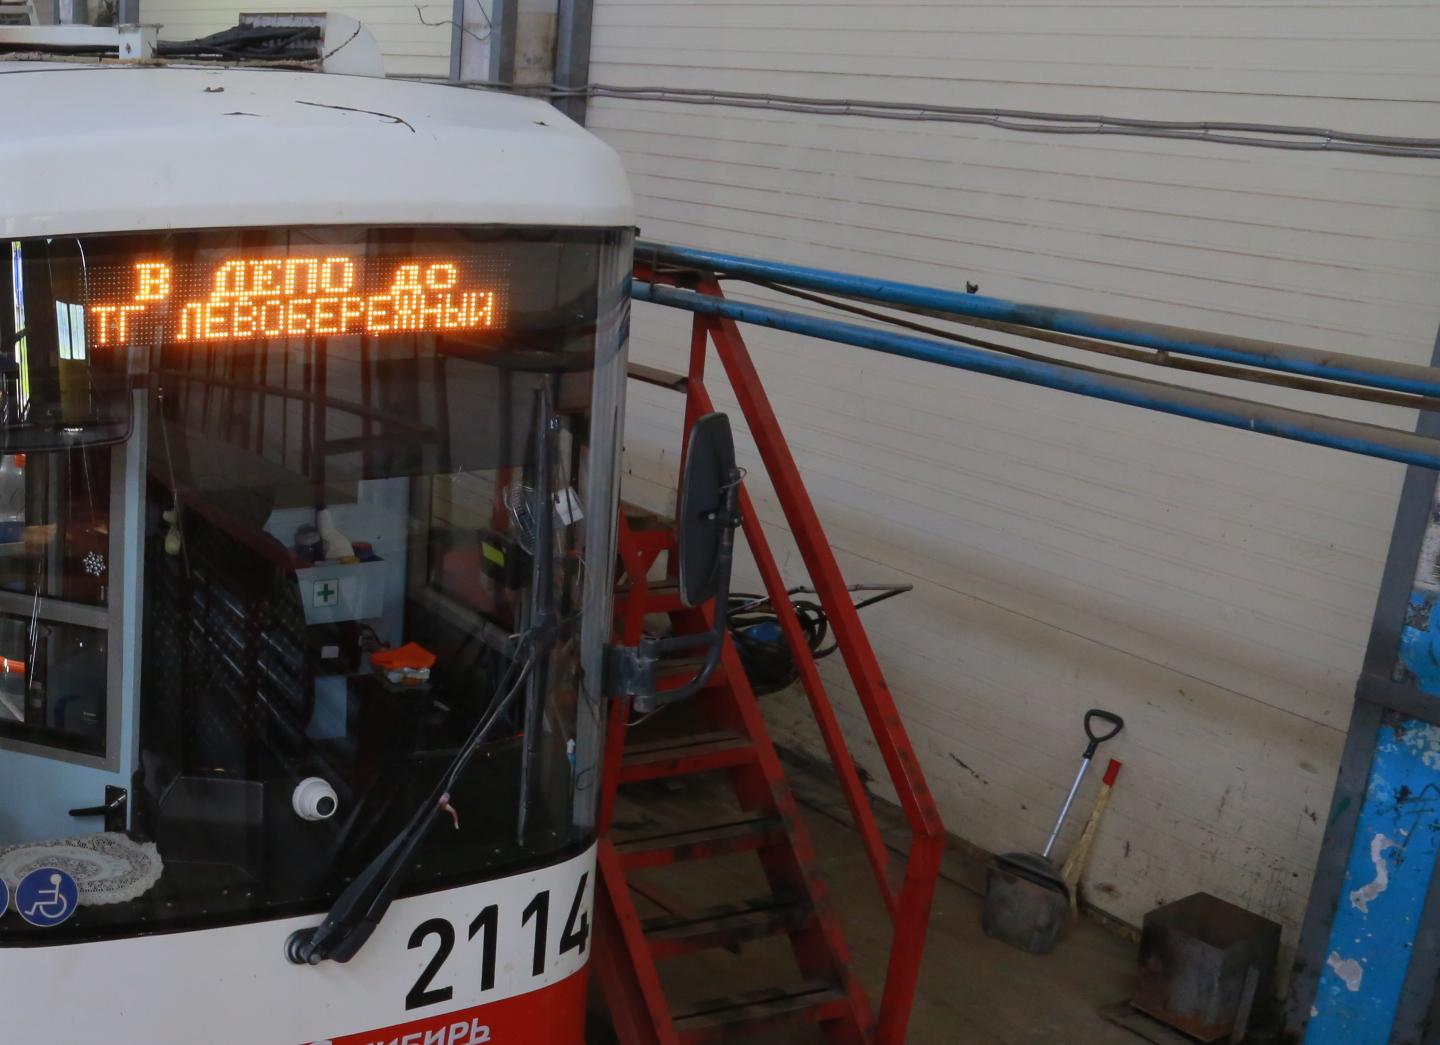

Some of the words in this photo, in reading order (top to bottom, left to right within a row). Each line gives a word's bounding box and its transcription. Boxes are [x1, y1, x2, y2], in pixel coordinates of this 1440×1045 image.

[135, 262, 171, 301] В
[210, 256, 354, 303] ДЕПО
[91, 305, 145, 343] ТГ
[175, 291, 494, 341] ЛЕВОБЕРЕЖНЫЙ
[404, 871, 591, 1012] 2114
